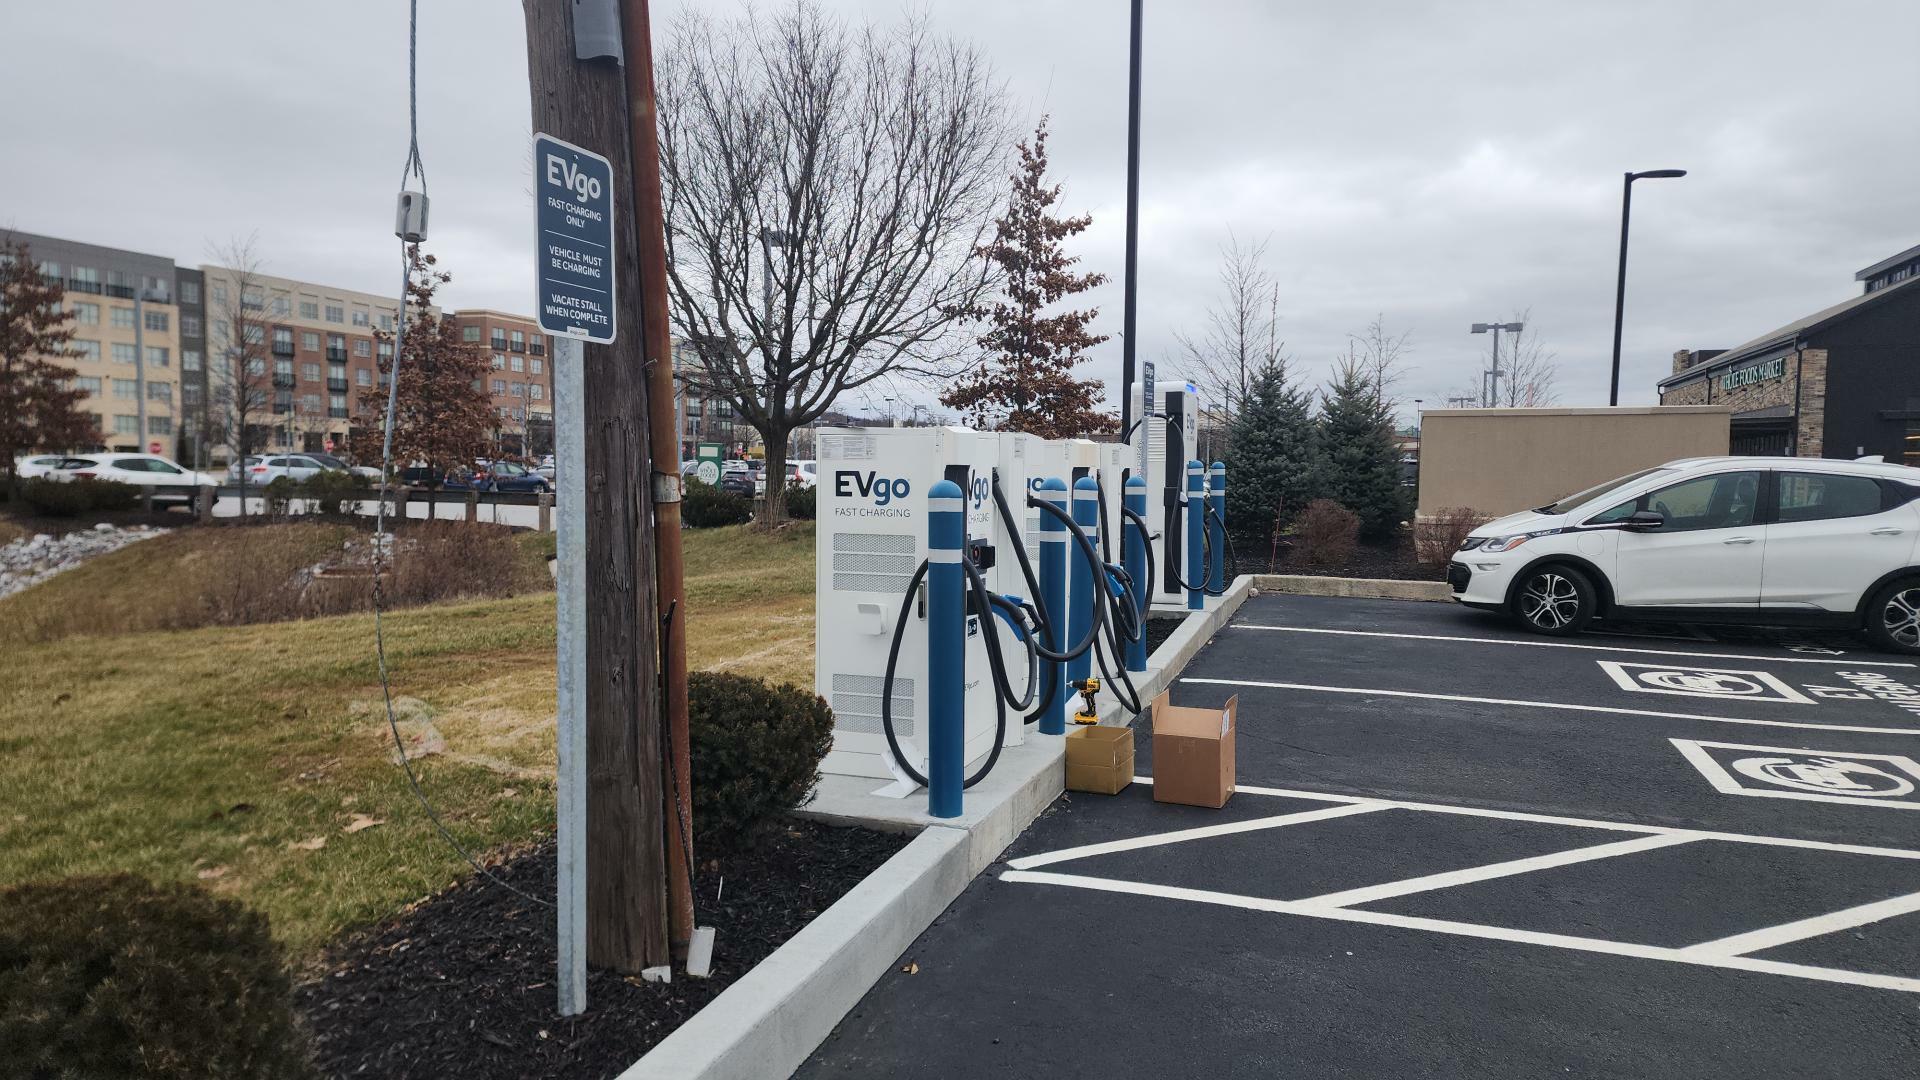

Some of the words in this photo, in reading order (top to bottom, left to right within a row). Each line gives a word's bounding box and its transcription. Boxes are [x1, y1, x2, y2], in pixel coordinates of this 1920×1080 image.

[547, 153, 601, 203] EVgo
[548, 197, 566, 211] FAST
[566, 202, 602, 222] CHARGING
[566, 214, 585, 229] ONLY
[549, 244, 581, 262] VEHICLE
[583, 253, 602, 267] MUST
[552, 257, 562, 269] BE
[562, 260, 601, 279] CHARGING
[551, 293, 580, 308] VACATE
[581, 299, 603, 313] STALL
[545, 304, 569, 318] WHEN
[569, 309, 608, 326] COMPLETE
[1721, 373, 1740, 390] WHOLE
[1740, 365, 1758, 386] FOODS
[1759, 357, 1783, 381] MARKET
[835, 470, 911, 506] EVgo
[967, 468, 989, 510] Vgo
[835, 507, 857, 517] FAST
[859, 508, 911, 518] CHARGING
